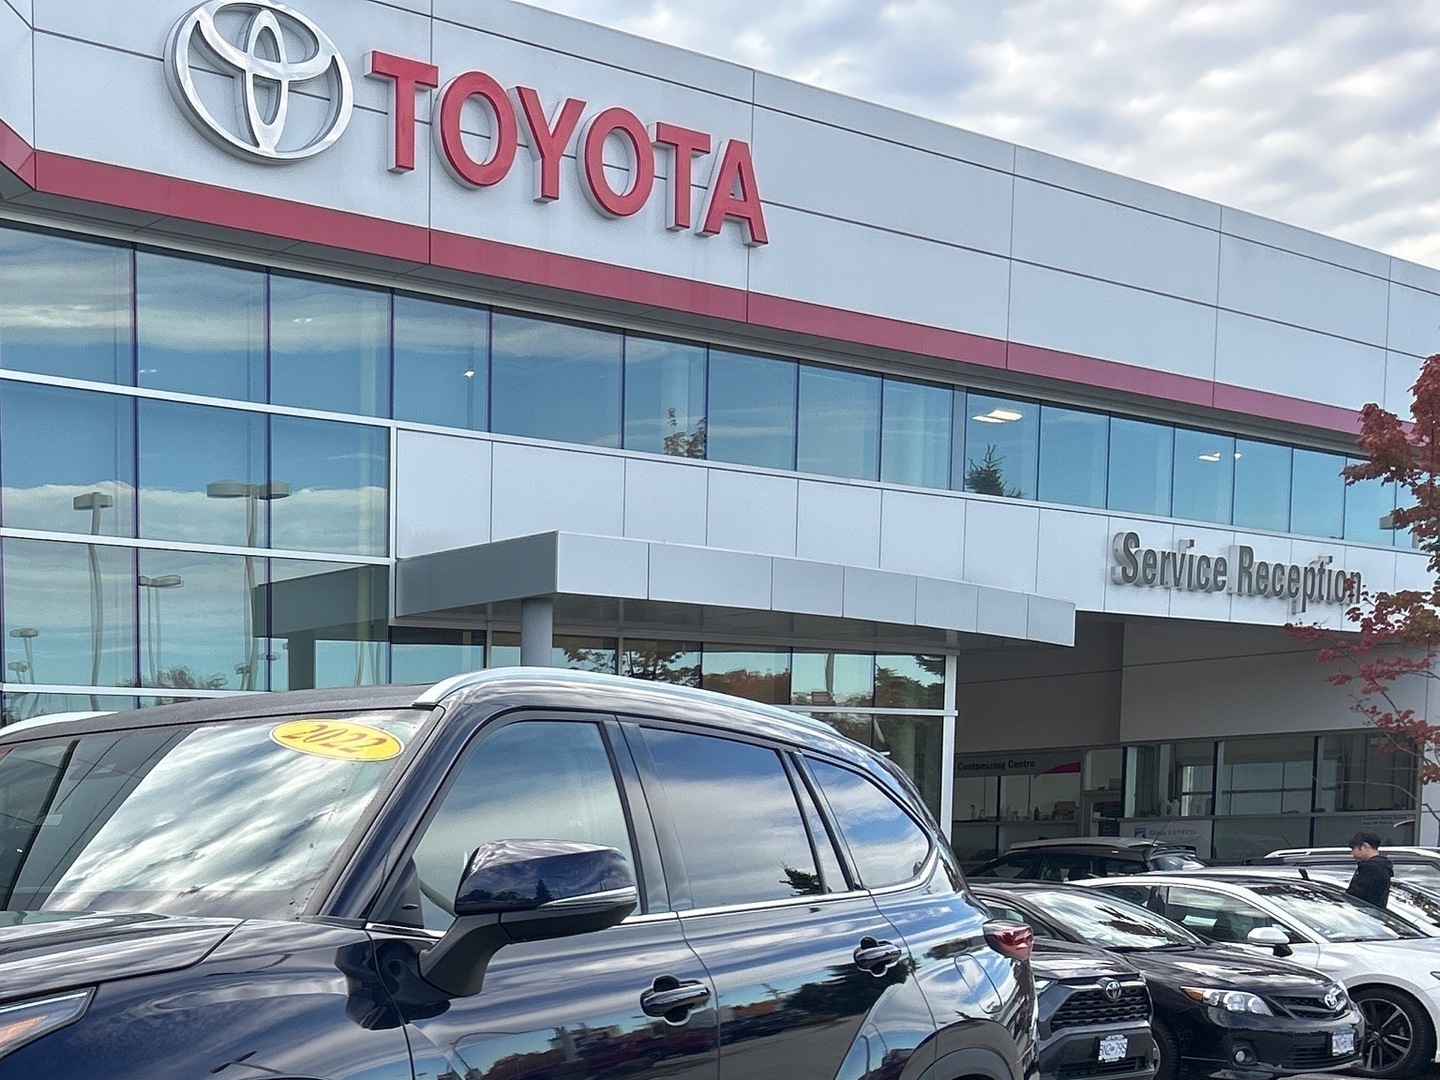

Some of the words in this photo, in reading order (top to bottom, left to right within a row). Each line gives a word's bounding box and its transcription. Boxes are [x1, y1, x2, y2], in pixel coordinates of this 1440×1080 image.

[363, 49, 769, 248] TOYOTA
[1112, 531, 1228, 593] Service
[1231, 544, 1362, 615] Reception
[280, 724, 388, 754] 2022
[957, 760, 1006, 771] Customizing
[1007, 759, 1036, 769] Centre
